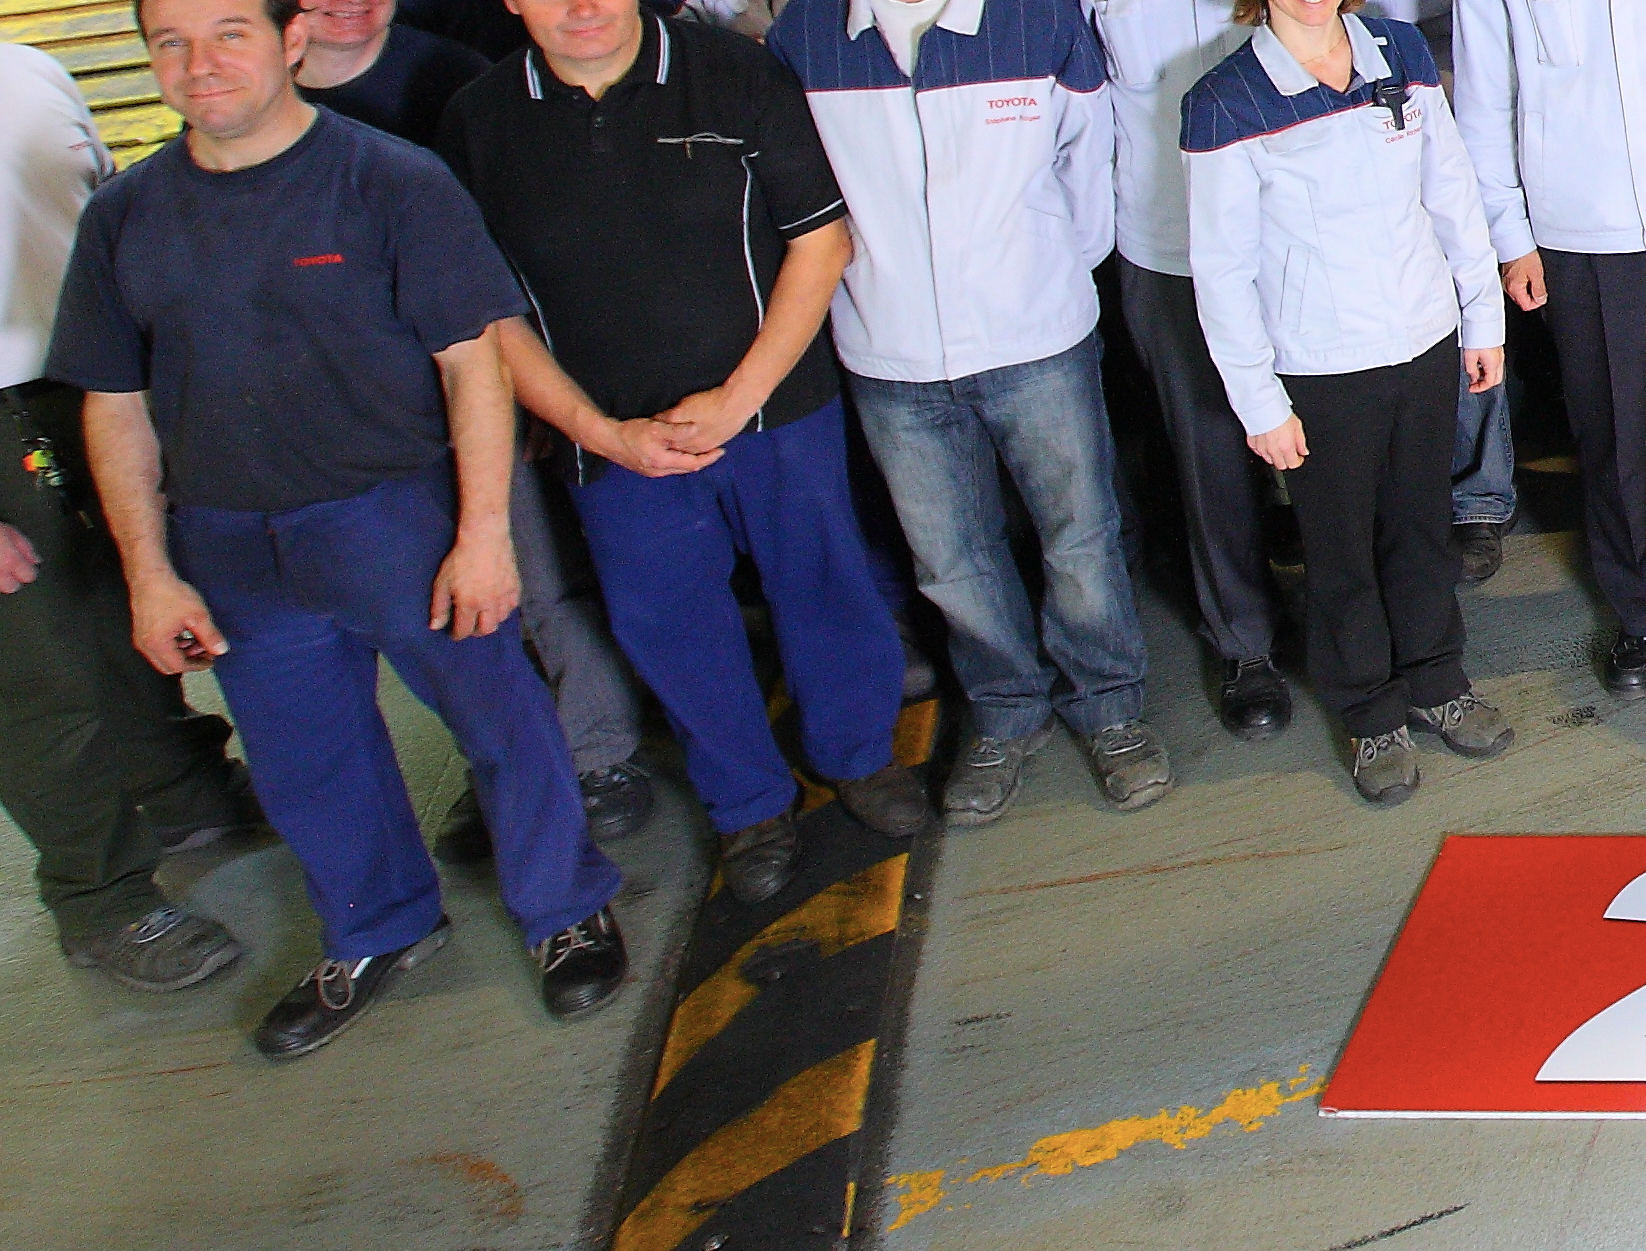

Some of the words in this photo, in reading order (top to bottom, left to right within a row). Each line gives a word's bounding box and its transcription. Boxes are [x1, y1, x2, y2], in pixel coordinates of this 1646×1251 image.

[987, 96, 1038, 110] TOYOTA
[1382, 108, 1423, 130] TOOTA
[293, 253, 344, 267] TOYOTA
